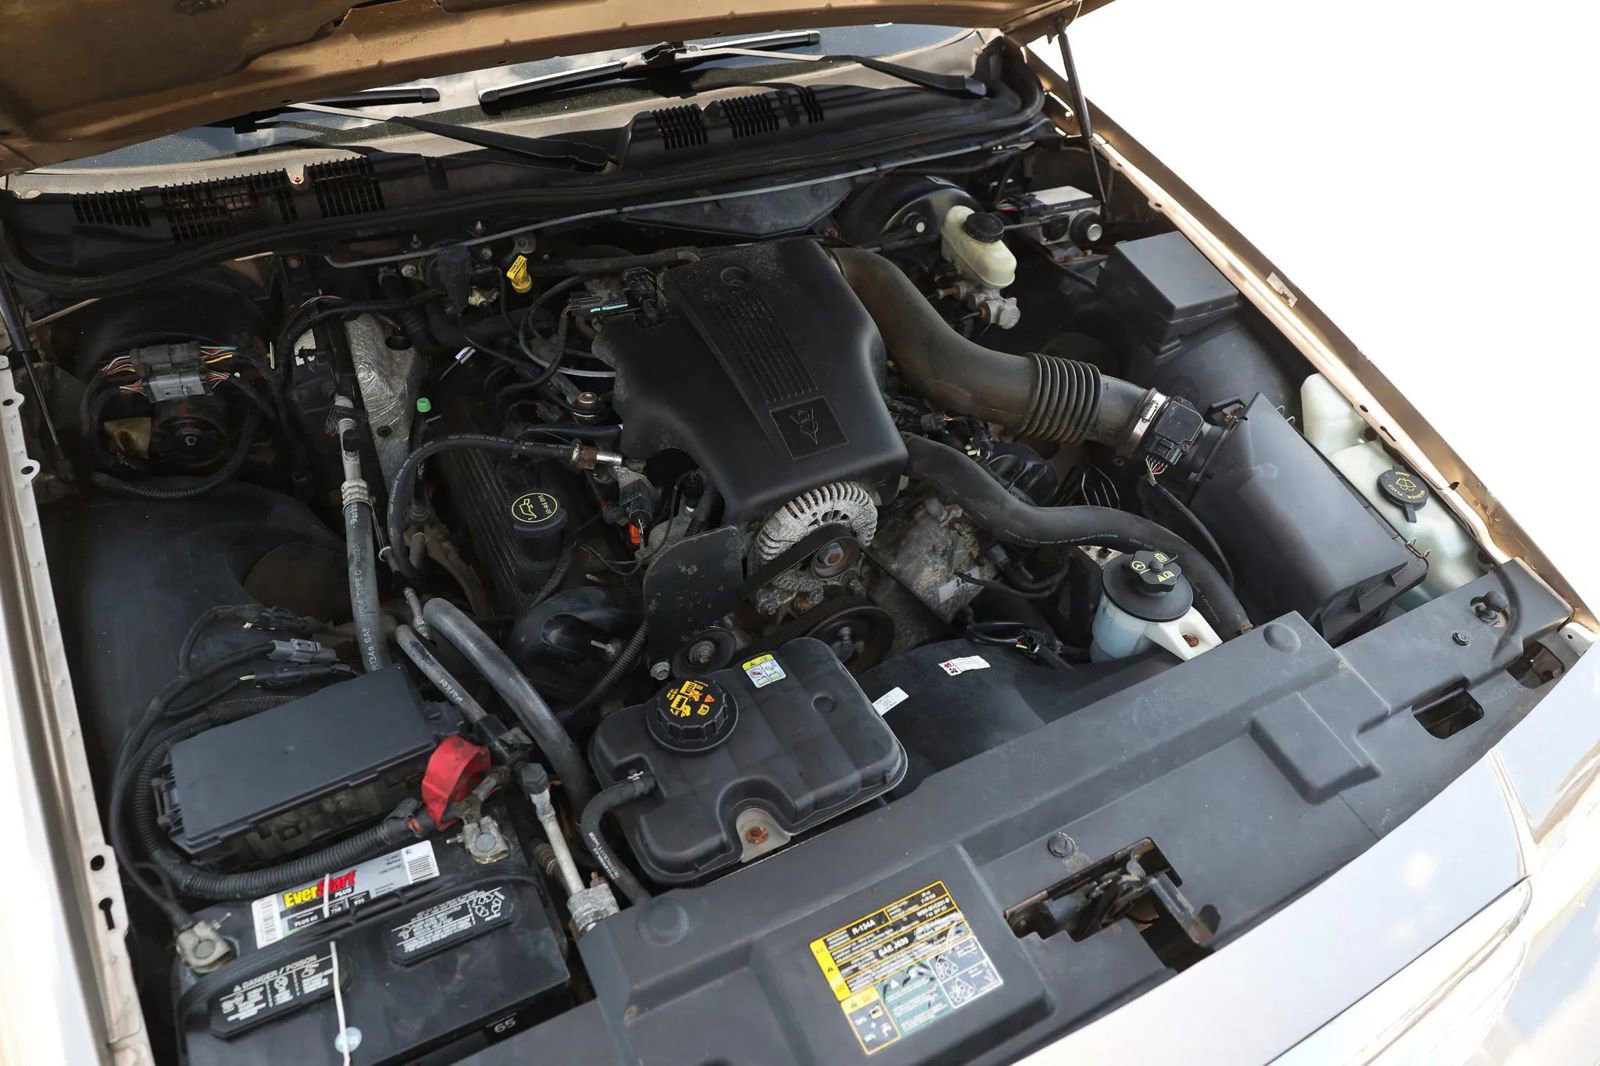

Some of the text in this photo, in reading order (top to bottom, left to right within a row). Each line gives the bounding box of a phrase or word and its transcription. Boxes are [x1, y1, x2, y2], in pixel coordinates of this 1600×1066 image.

[334, 886, 353, 898] PLUS
[851, 919, 877, 936] R-134A
[241, 970, 278, 989] DANGER
[286, 954, 318, 972] POISON
[494, 1017, 517, 1033] 65
